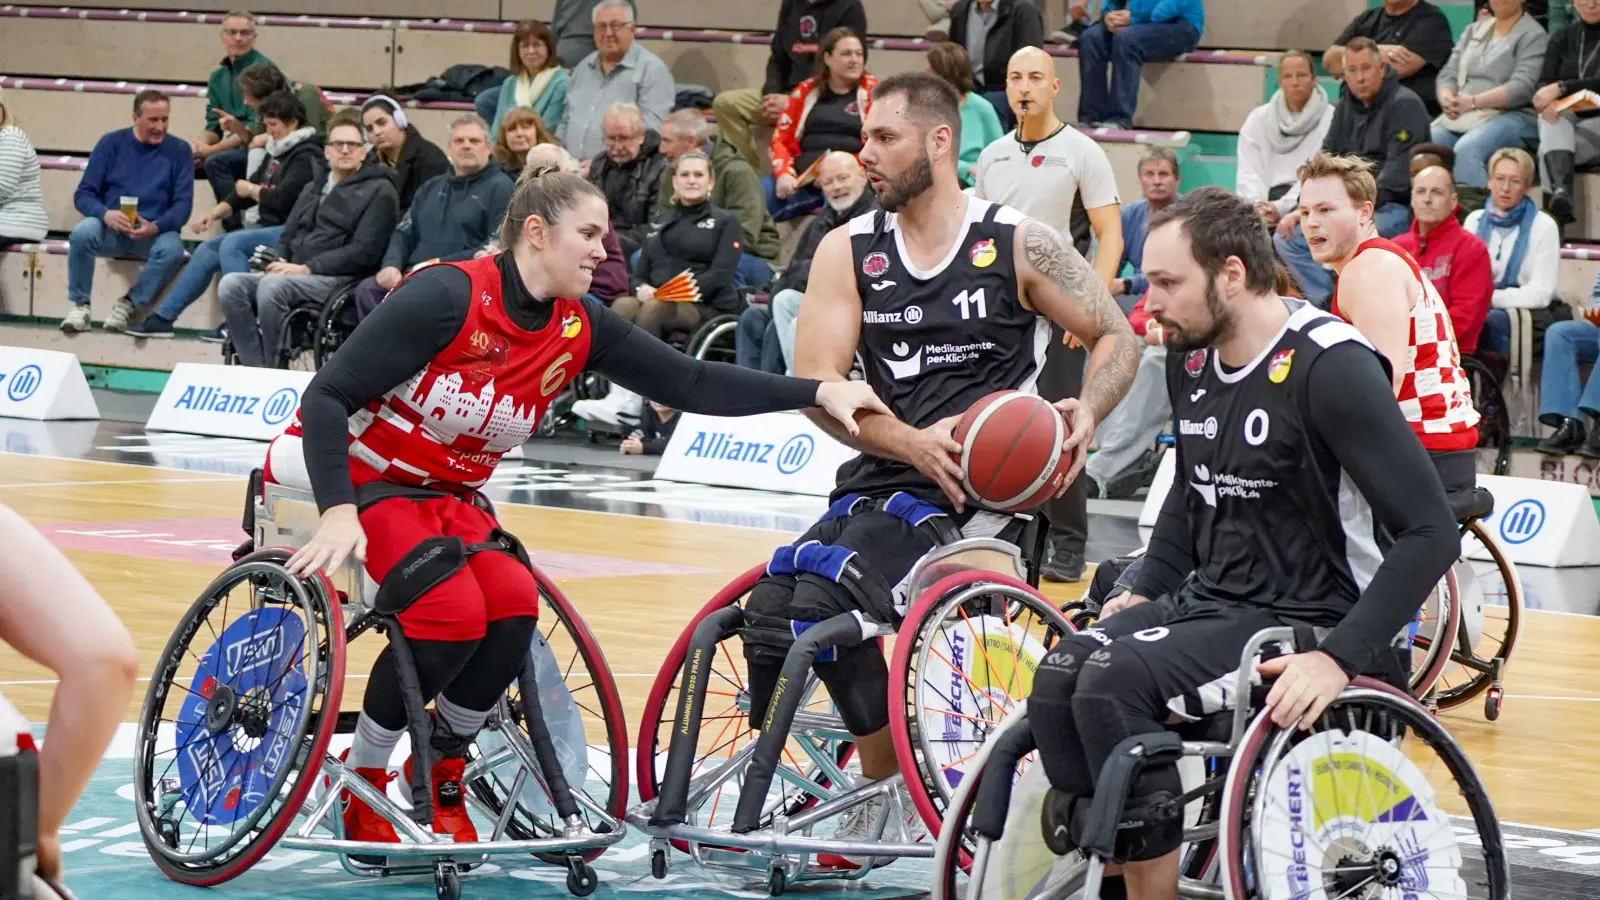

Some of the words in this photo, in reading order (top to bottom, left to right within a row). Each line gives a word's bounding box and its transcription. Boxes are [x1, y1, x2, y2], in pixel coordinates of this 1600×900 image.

[863, 310, 903, 324] Allianz
[952, 288, 987, 320] 11
[470, 330, 489, 349] 40
[926, 341, 996, 355] Medikamente-
[540, 352, 572, 396] 6
[926, 352, 980, 366] per-Klick.de
[173, 385, 261, 415] Allianz
[1244, 408, 1270, 446] 0
[684, 431, 775, 464] Allianz
[691, 648, 702, 674] FRAME
[687, 671, 697, 694] 7020
[951, 629, 966, 728] BECHERT
[681, 693, 693, 734] ALUMINIUM
[1286, 764, 1309, 882] BECHERT
